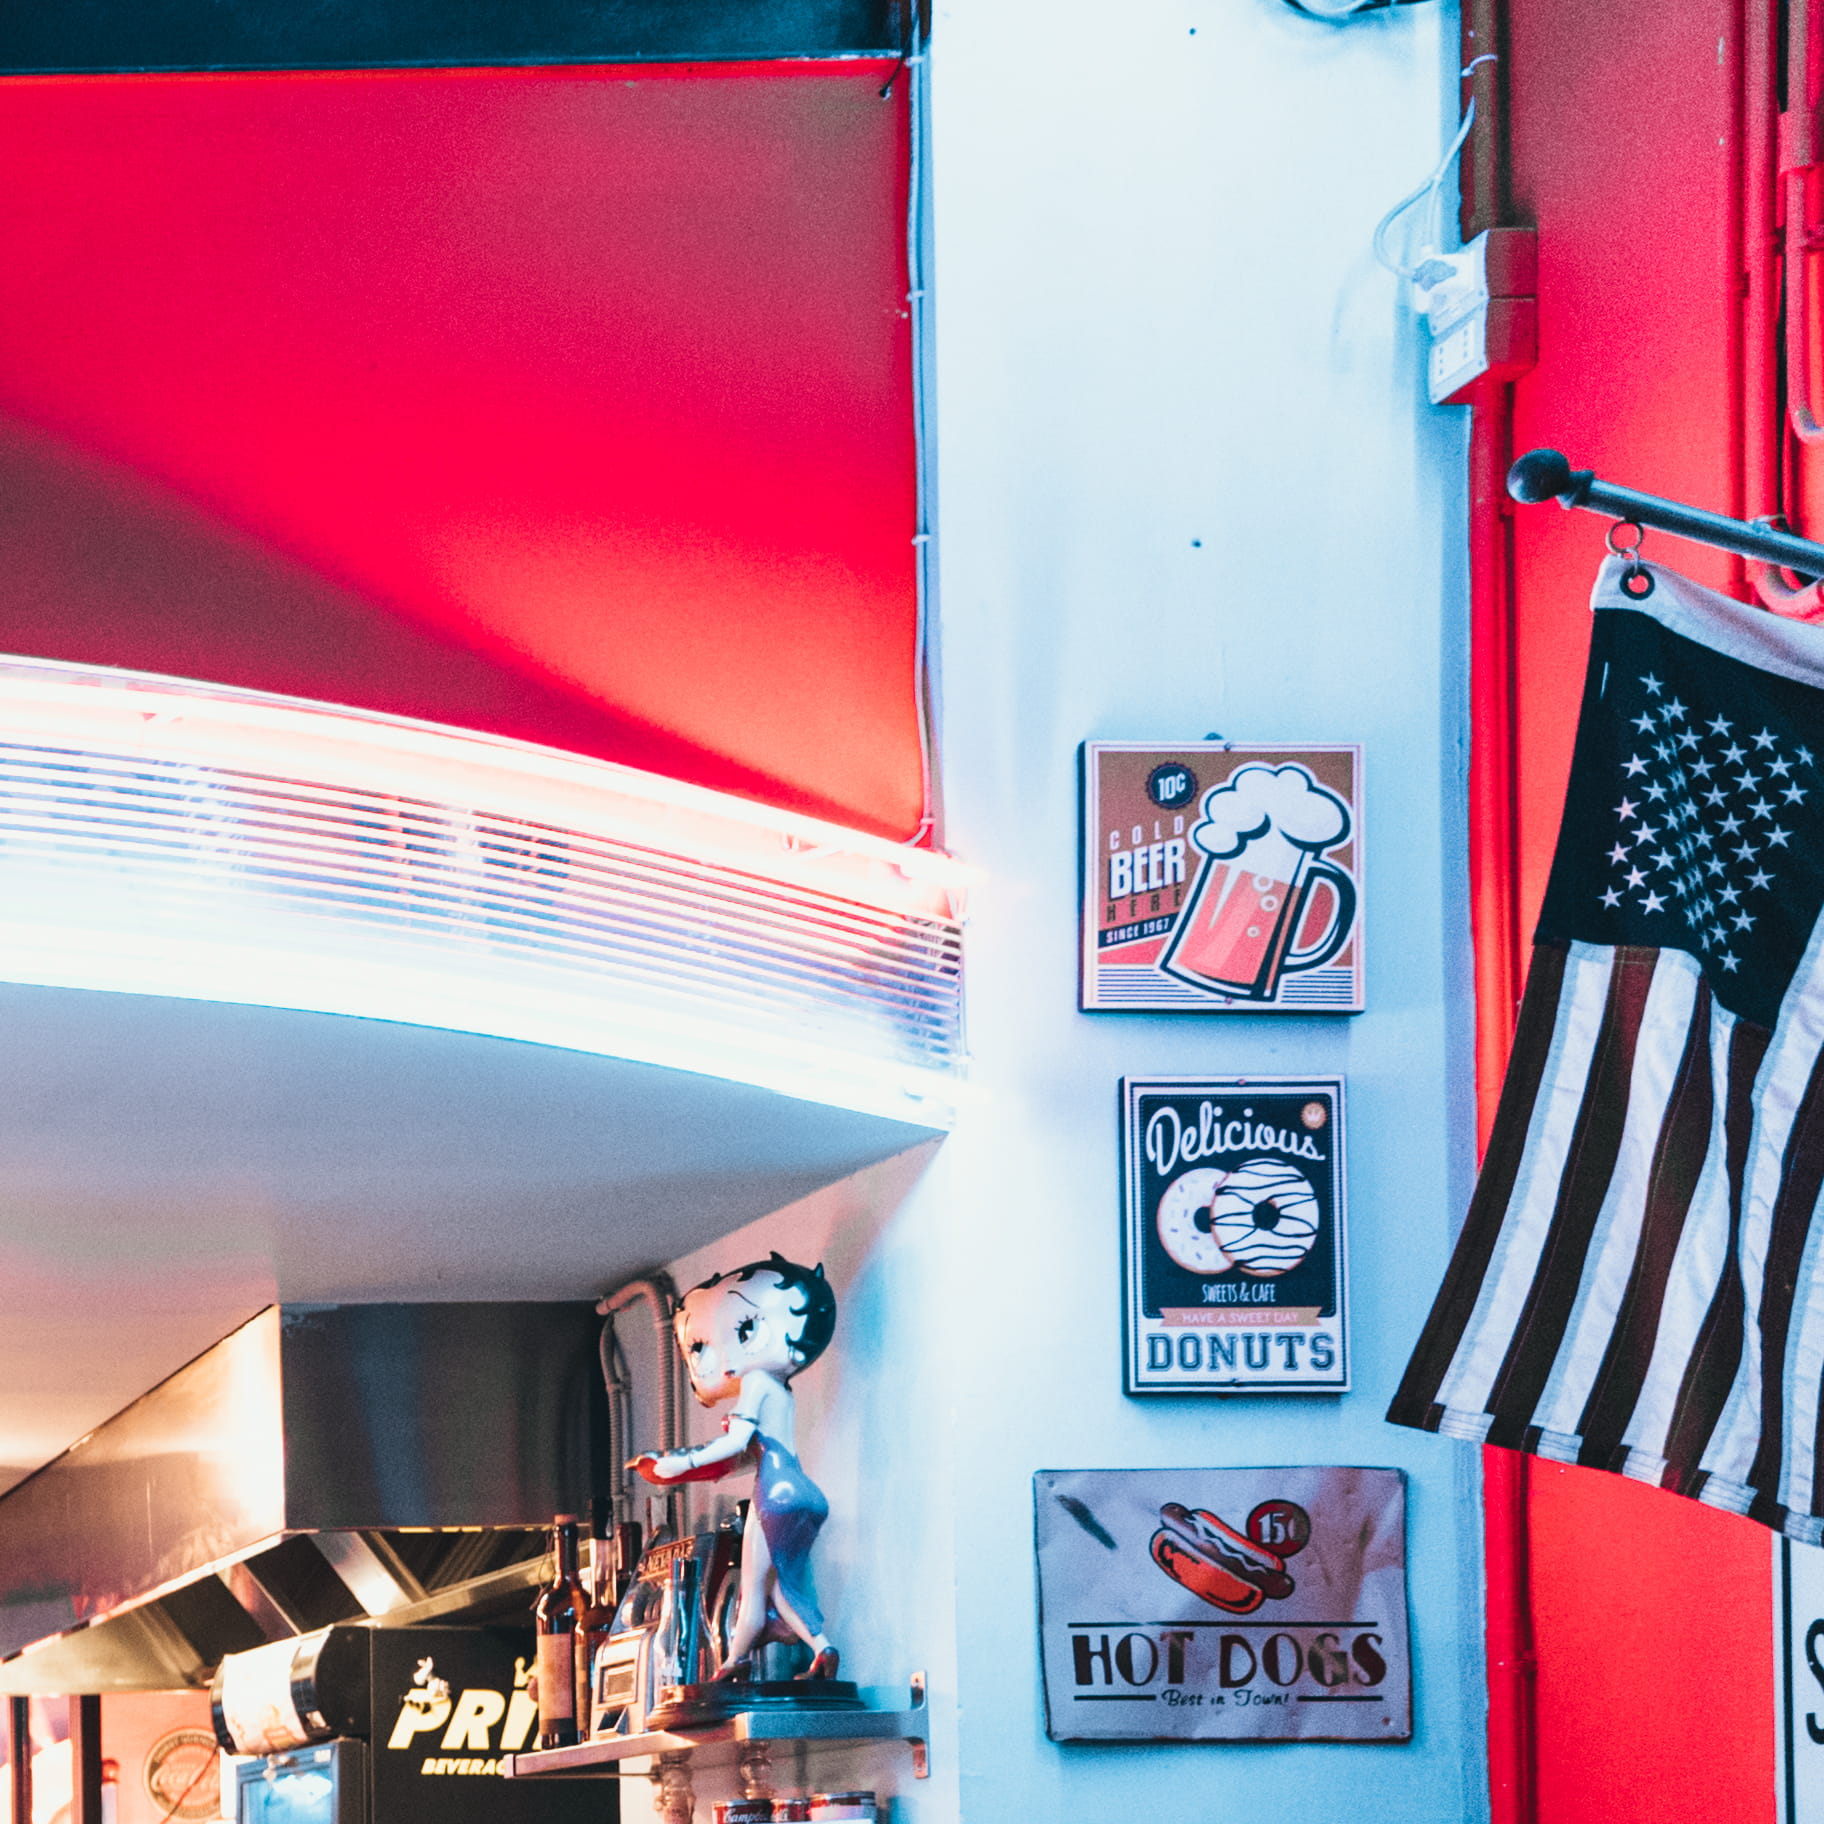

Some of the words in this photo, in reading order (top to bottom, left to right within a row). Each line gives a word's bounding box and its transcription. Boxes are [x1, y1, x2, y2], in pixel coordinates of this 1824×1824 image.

[1109, 815, 1184, 850] COLD
[1109, 837, 1186, 901] BEER
[1106, 888, 1182, 923] HERE
[1106, 923, 1139, 944] SINCE
[1143, 917, 1170, 935] 1967
[1145, 1100, 1326, 1177] Delicious
[1202, 1283, 1237, 1303] SWEETS
[1252, 1283, 1276, 1303] CAFE
[1182, 1312, 1214, 1324] HAVE
[1218, 1312, 1226, 1323] A
[1231, 1311, 1269, 1323] SWEET
[1275, 1312, 1298, 1323] DAY
[1145, 1332, 1336, 1372] DONUTS
[1072, 1631, 1194, 1686] HOT
[1219, 1632, 1387, 1688] DOGS
[1161, 1689, 1203, 1706] Best
[1210, 1692, 1226, 1706] in
[1234, 1688, 1289, 1706] Town!
